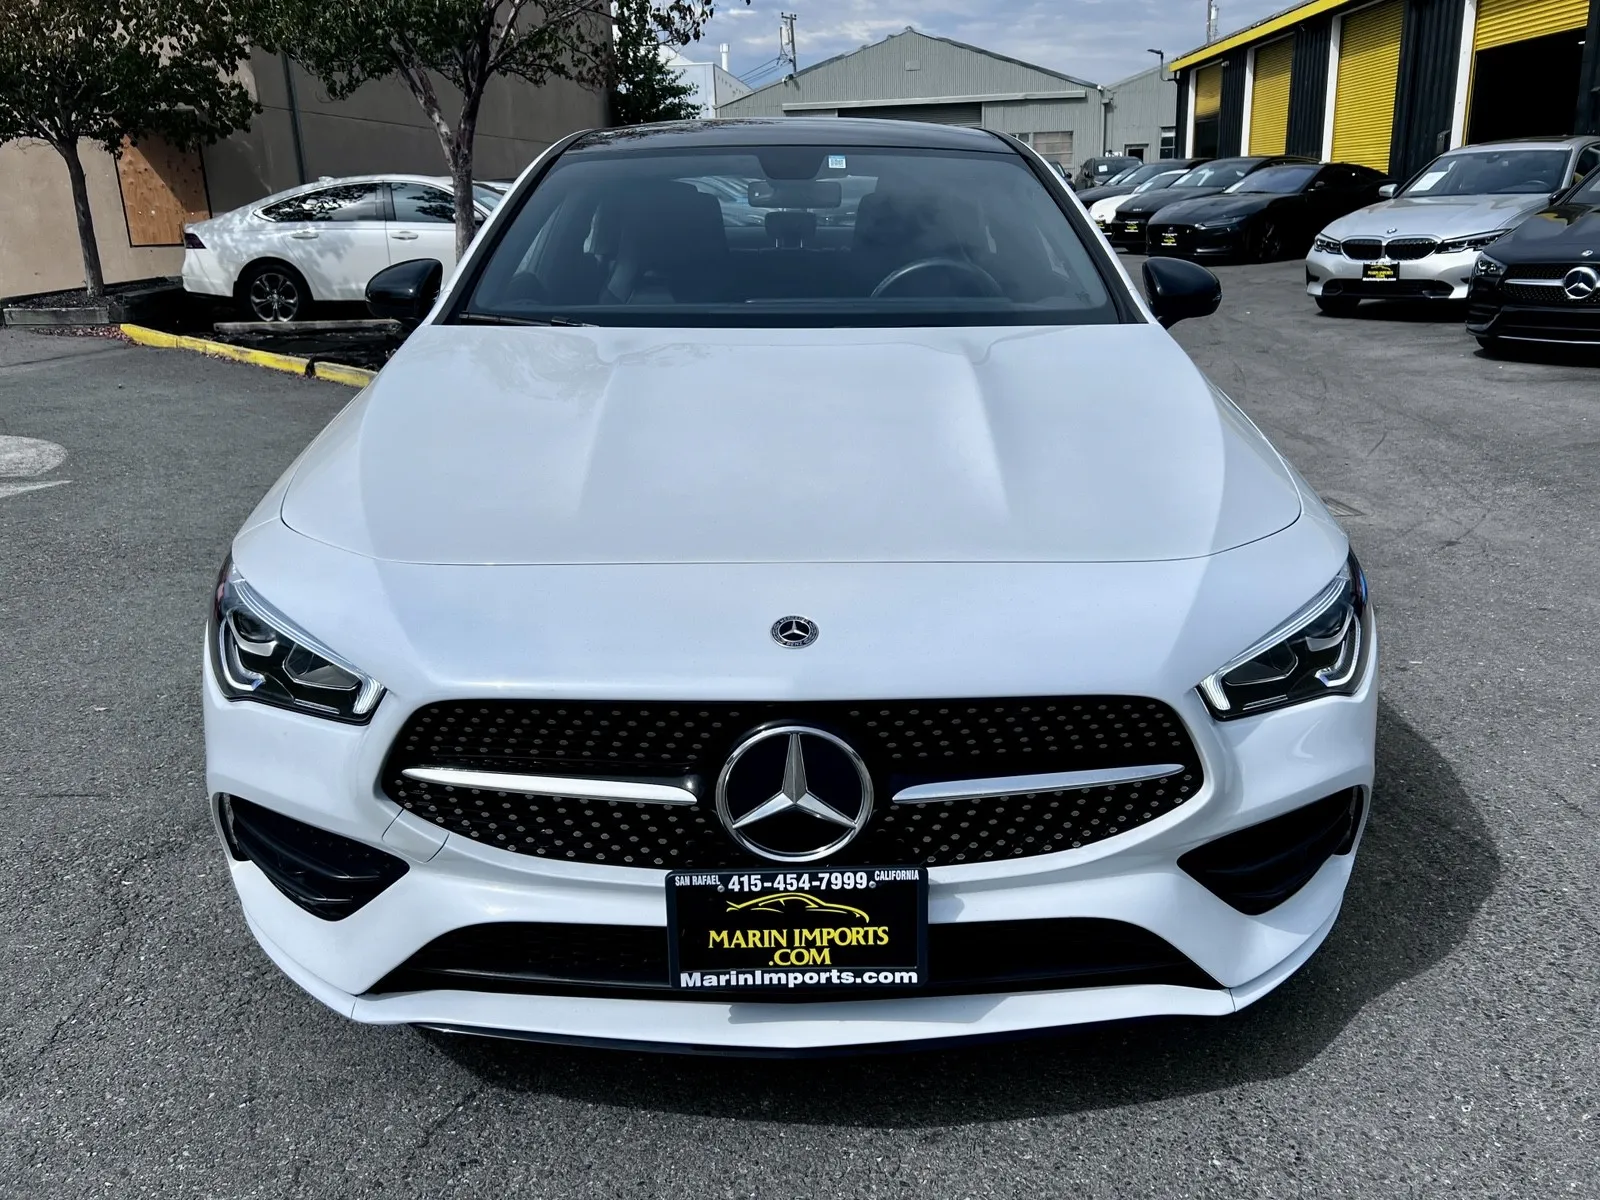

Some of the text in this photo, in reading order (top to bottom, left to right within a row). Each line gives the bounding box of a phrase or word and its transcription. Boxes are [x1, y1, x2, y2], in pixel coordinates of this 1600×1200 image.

[675, 869, 919, 892] SAN RAFAEL 415-454-7999 CALIFORNIA
[708, 926, 889, 949] MARIN IMPORTS
[768, 948, 832, 966] .COM
[680, 969, 918, 988] MarinImports.com
